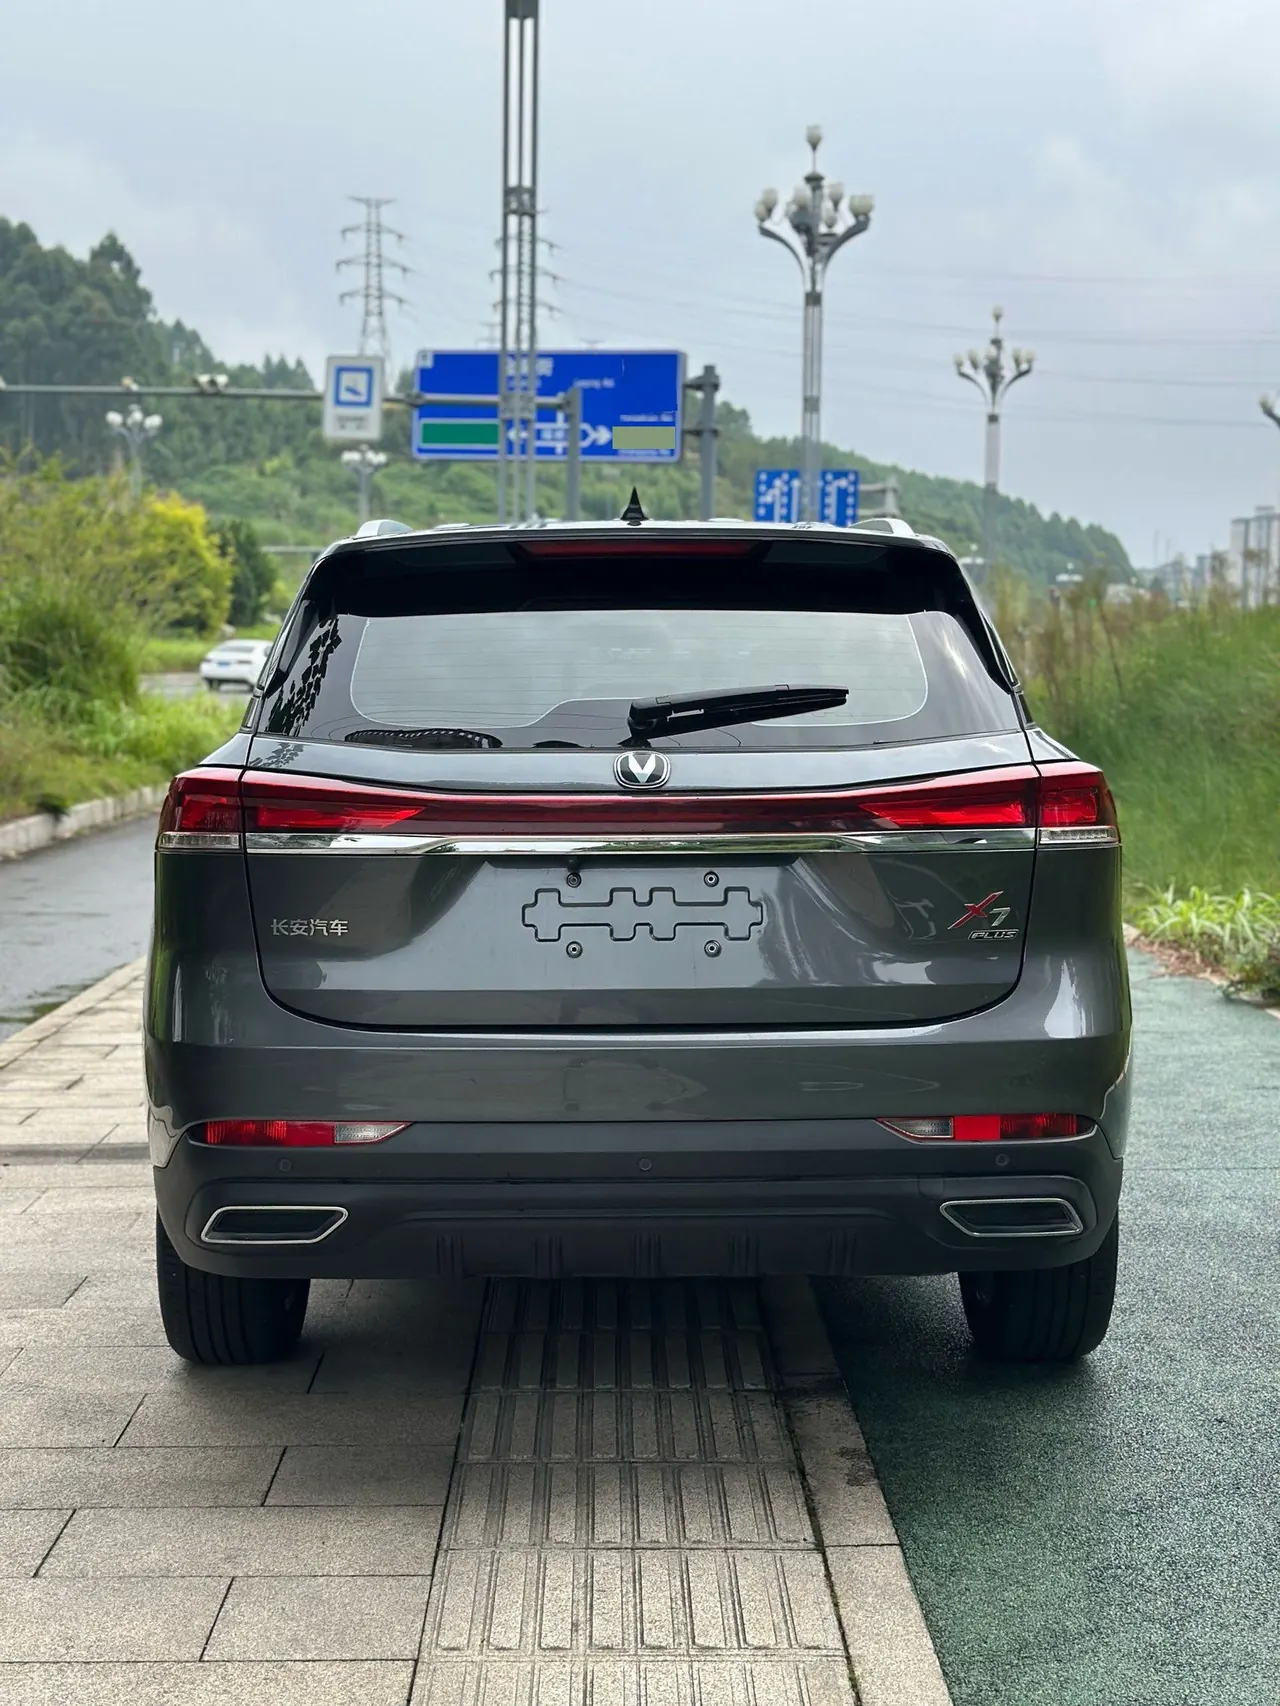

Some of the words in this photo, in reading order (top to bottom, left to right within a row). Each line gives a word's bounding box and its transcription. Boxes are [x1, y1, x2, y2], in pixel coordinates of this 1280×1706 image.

[947, 890, 1011, 929] X7
[271, 919, 348, 936] 长安汽车
[970, 930, 1017, 939] PLUS
